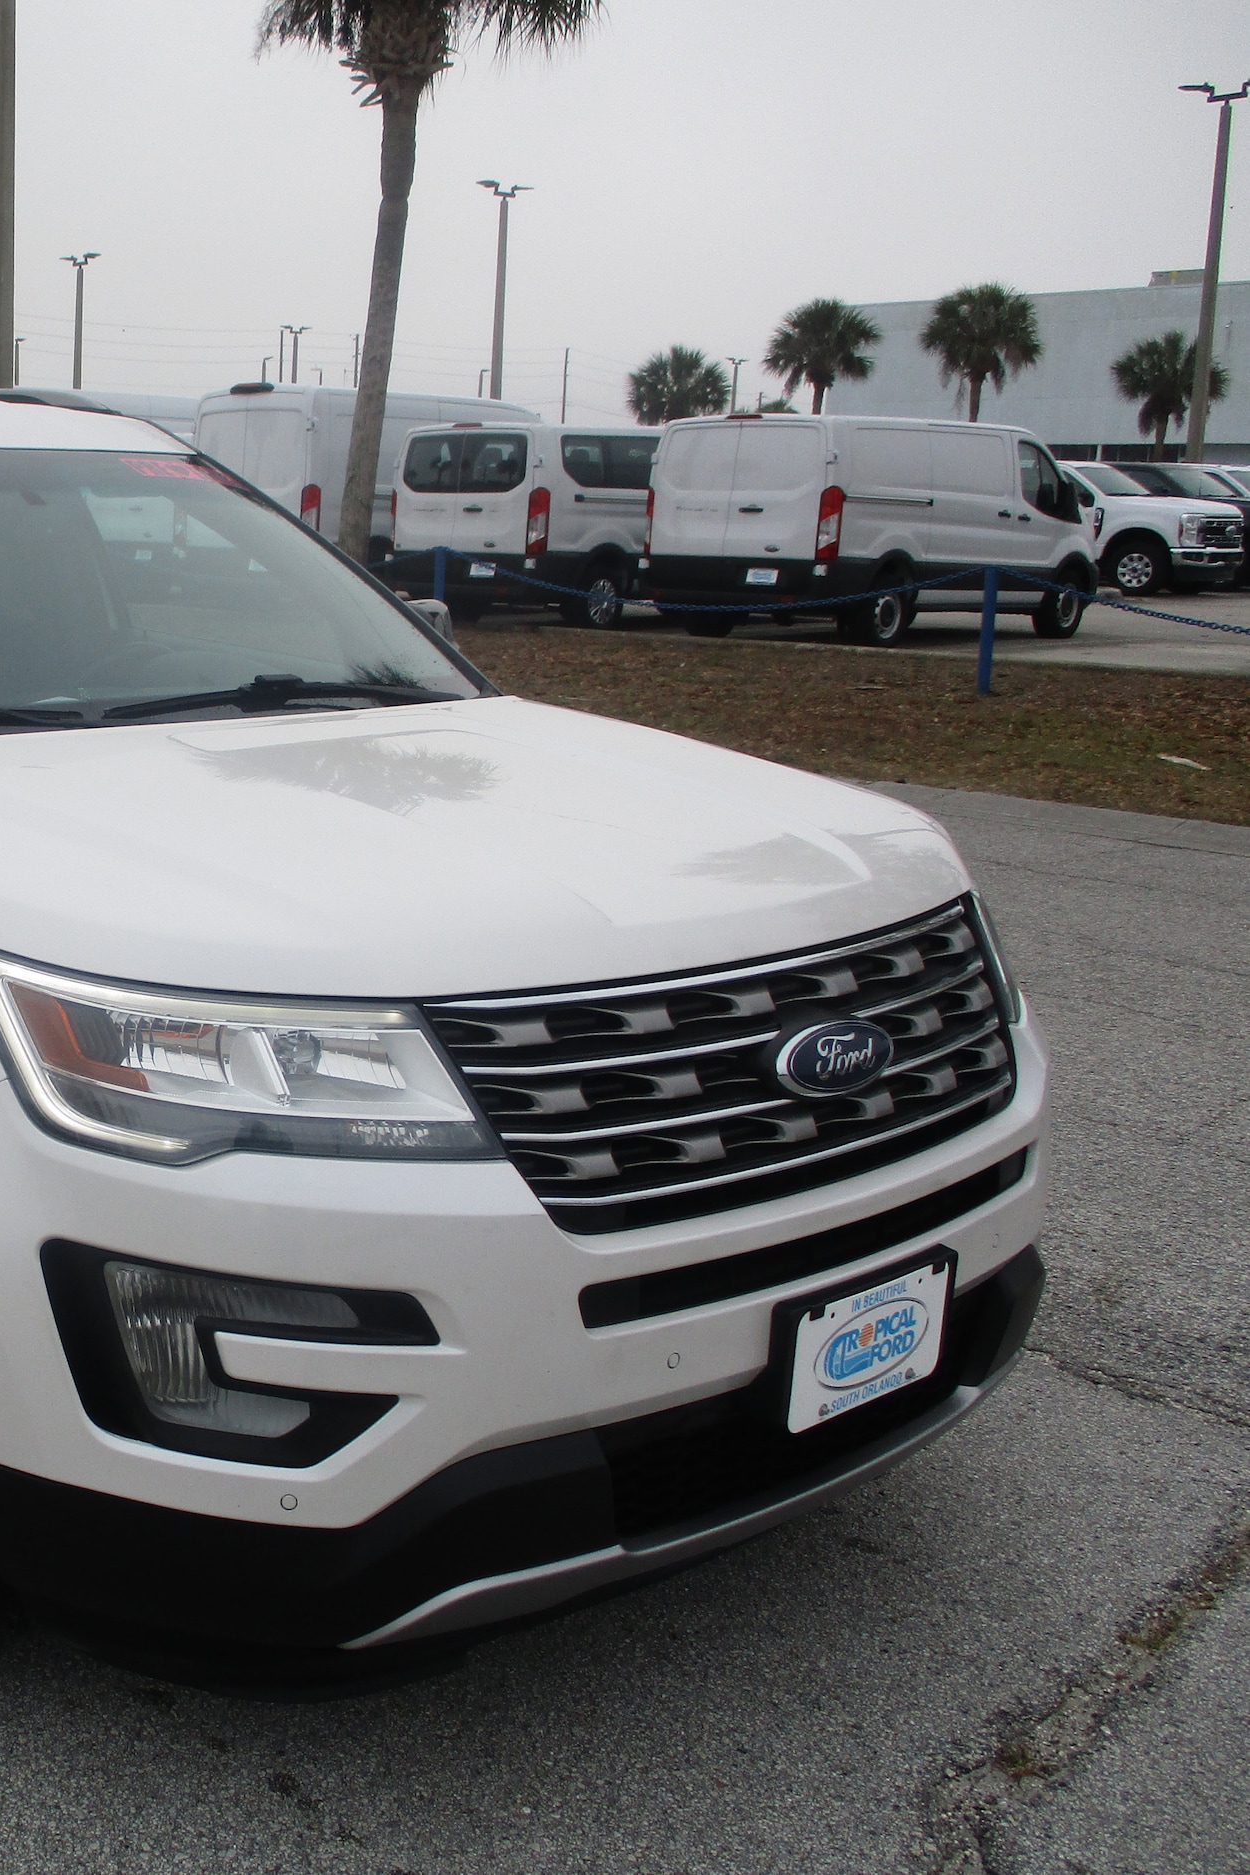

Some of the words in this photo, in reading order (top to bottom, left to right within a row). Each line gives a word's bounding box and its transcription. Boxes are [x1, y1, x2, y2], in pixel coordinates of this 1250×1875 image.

[816, 1032, 875, 1080] Ford
[851, 1299, 861, 1313] IN
[863, 1281, 908, 1308] BEAUTIFUL
[825, 1306, 917, 1376] TROPICAL
[869, 1330, 915, 1366] FORD
[831, 1391, 859, 1412] SOUTH
[862, 1372, 902, 1399] ORLANDO
